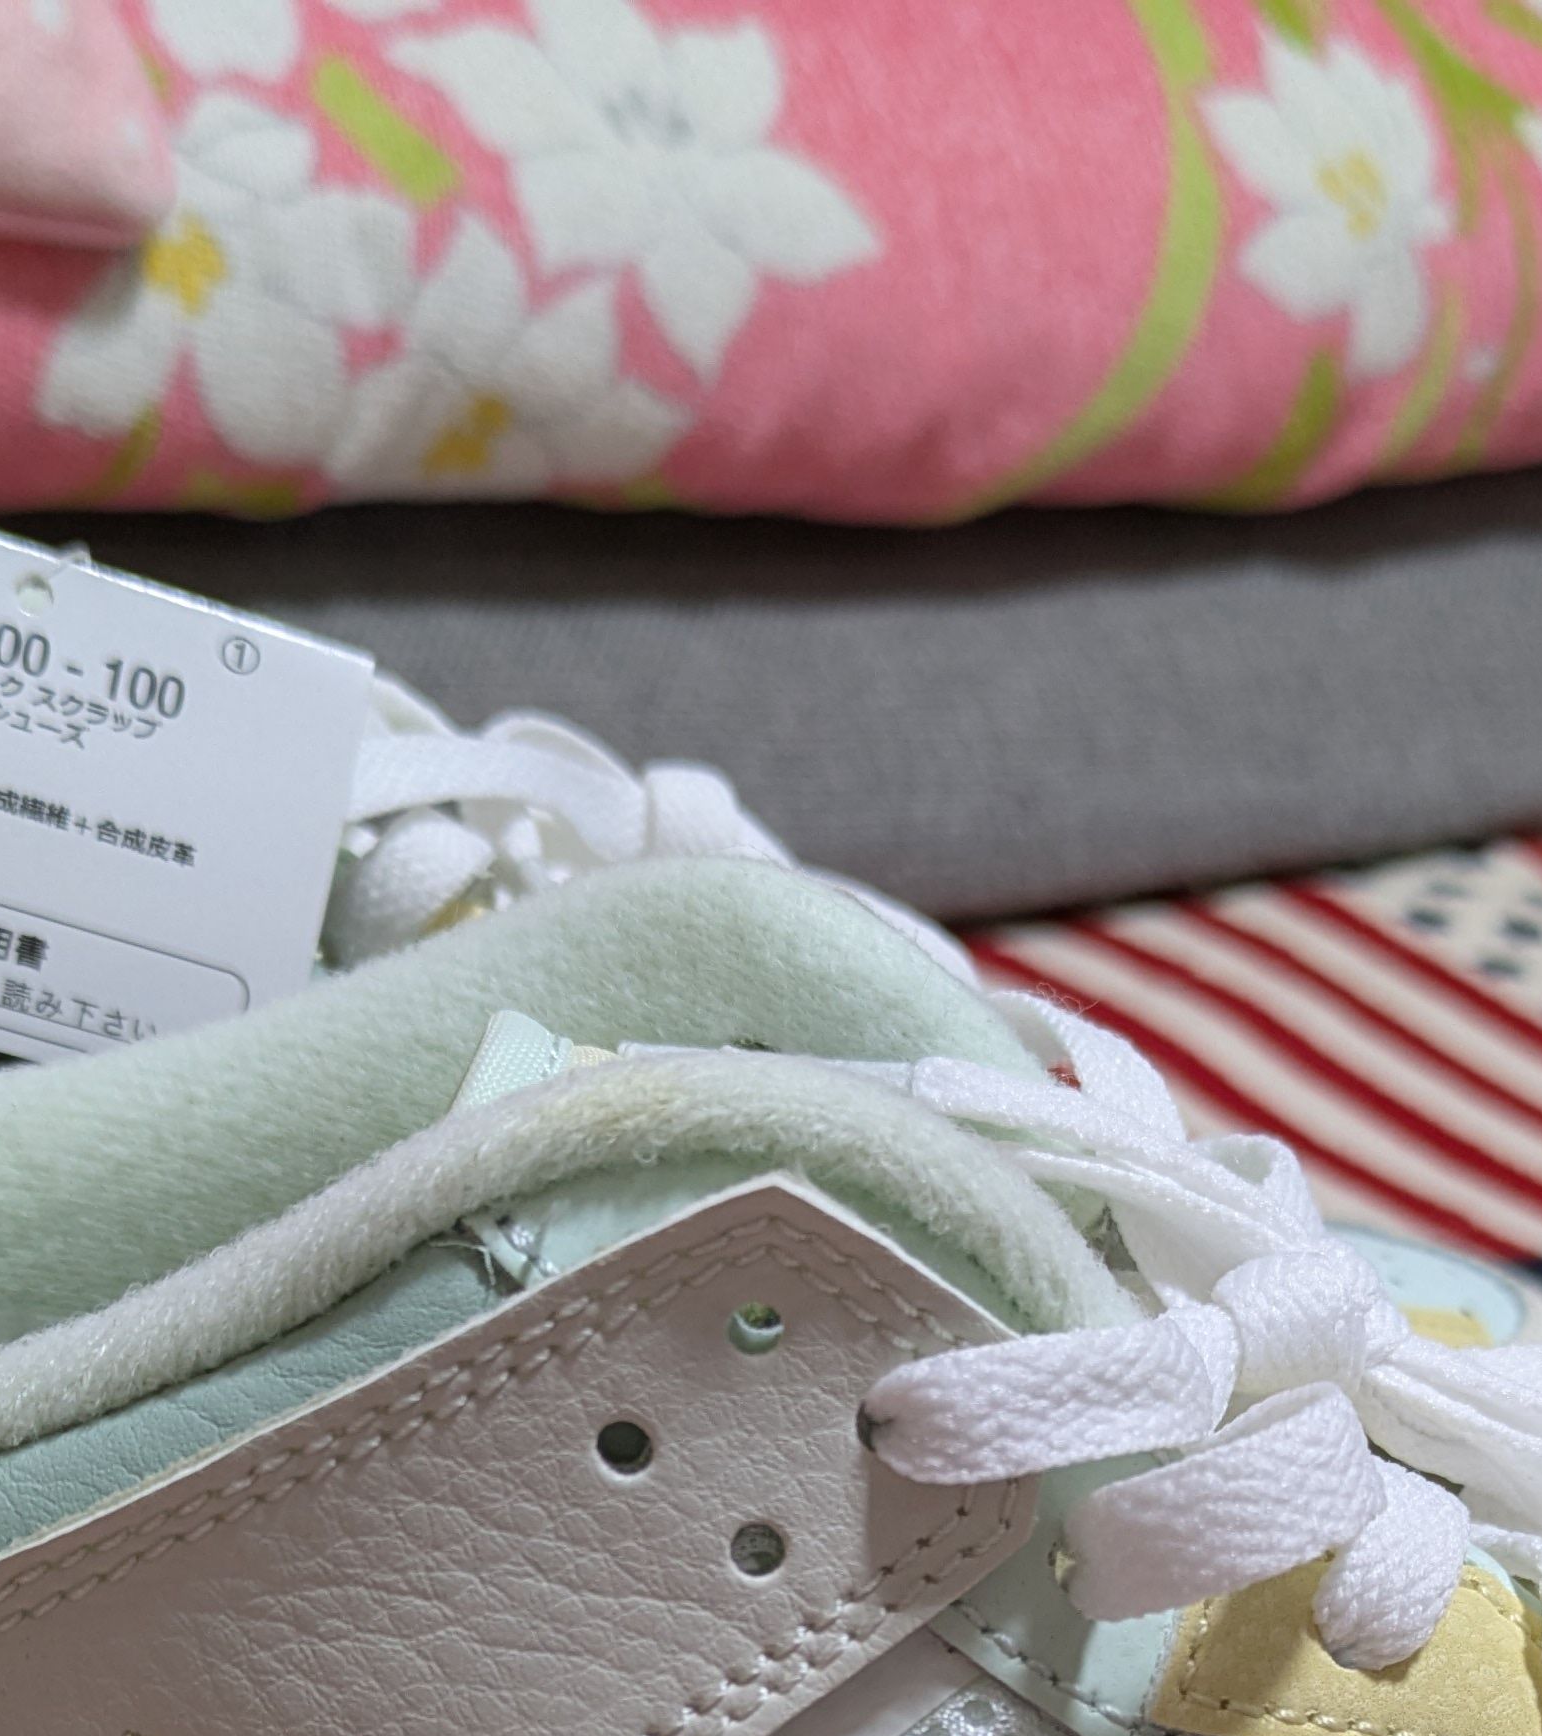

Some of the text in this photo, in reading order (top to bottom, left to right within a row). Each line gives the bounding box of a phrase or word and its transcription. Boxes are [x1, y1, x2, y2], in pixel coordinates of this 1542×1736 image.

[32, 685, 163, 740] スクラップ
[105, 659, 185, 719] 100
